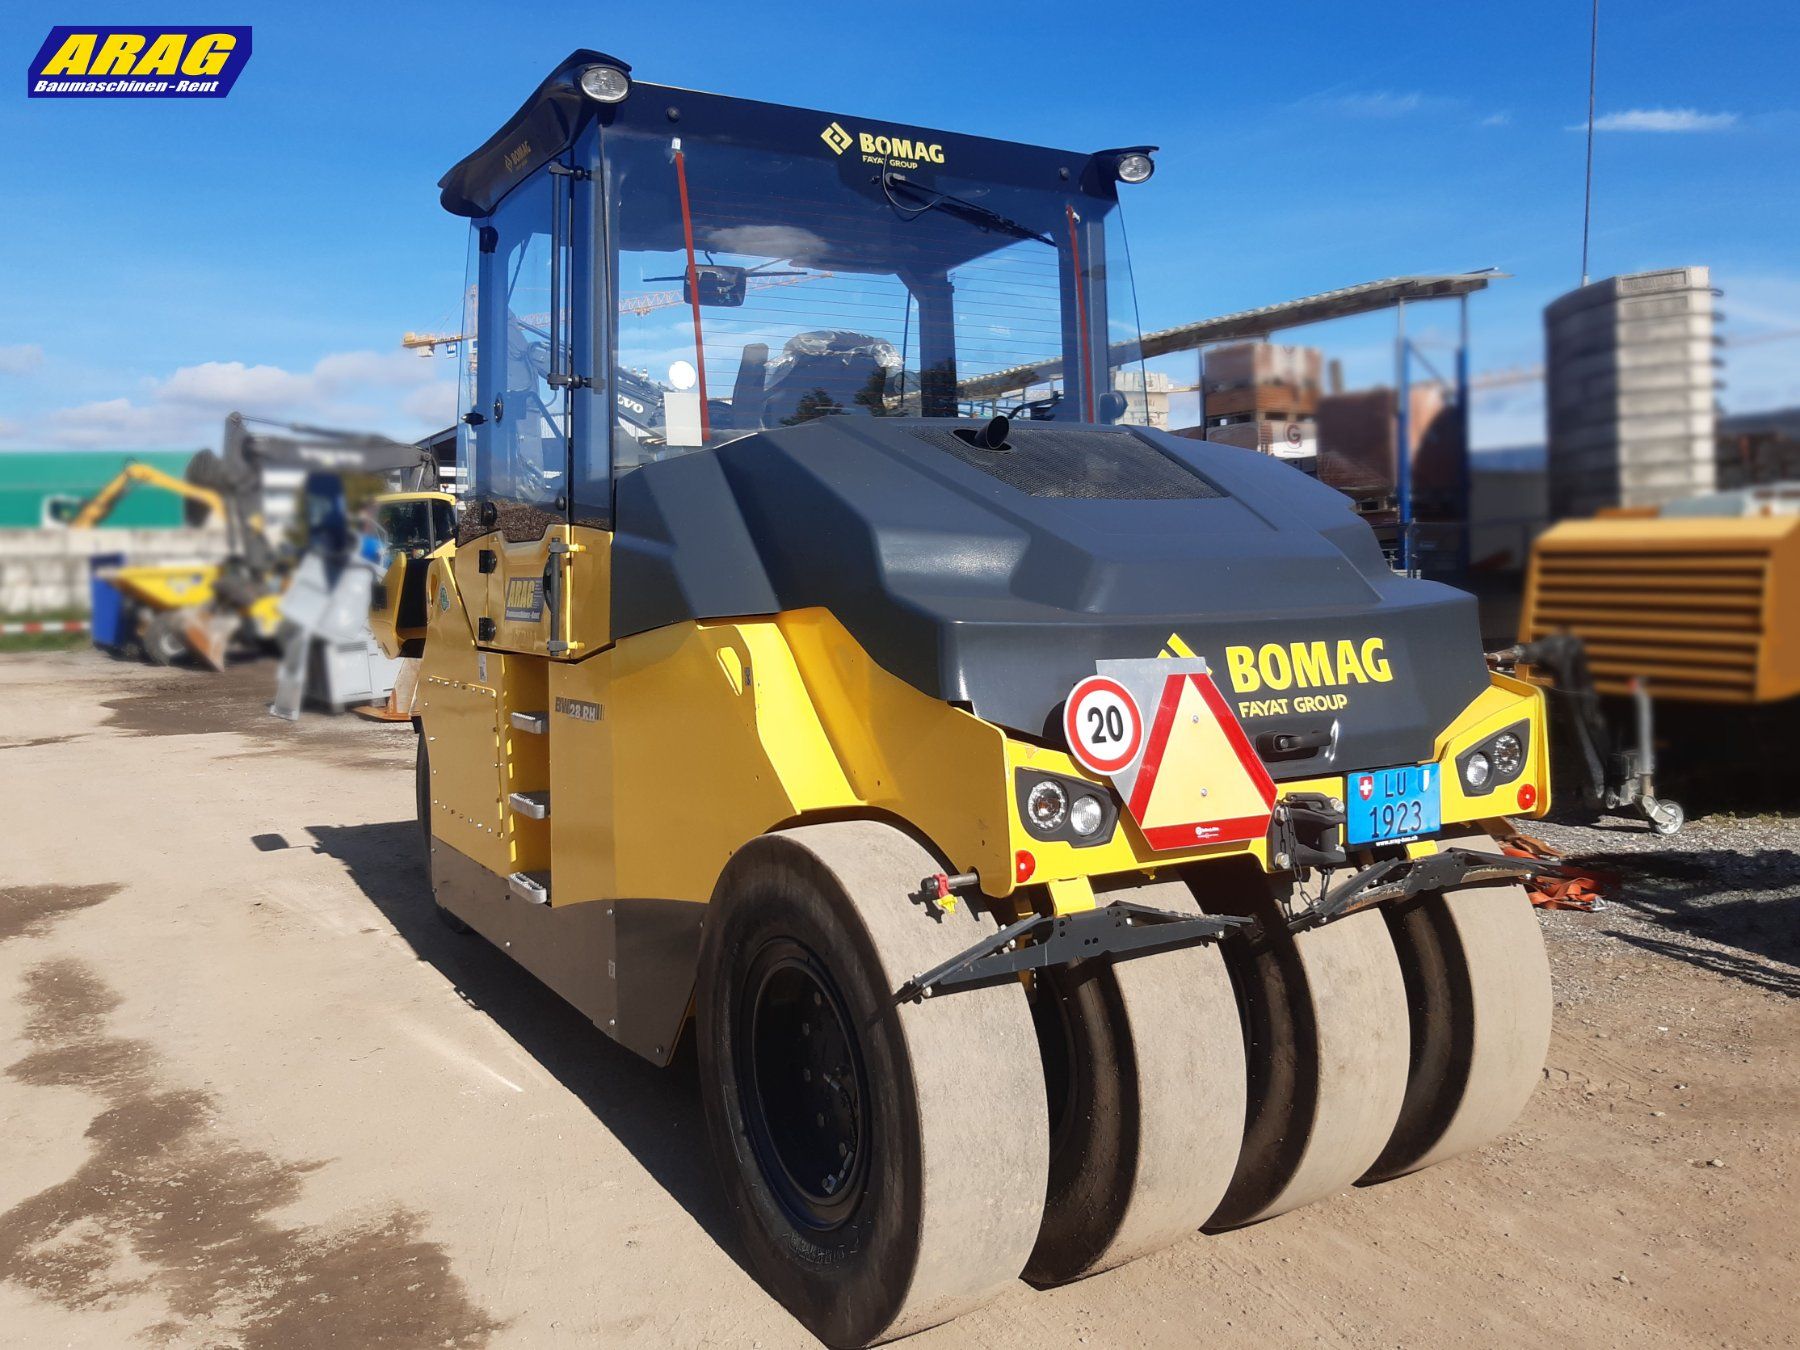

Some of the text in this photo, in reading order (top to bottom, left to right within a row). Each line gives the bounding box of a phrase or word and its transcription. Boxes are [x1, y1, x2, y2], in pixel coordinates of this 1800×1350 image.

[859, 132, 945, 163] BOMAG
[889, 159, 918, 169] GROUP
[506, 580, 535, 609] ARAG
[1225, 637, 1394, 693] BOMAG
[1238, 694, 1348, 718] FAYAT GROUP
[1087, 704, 1124, 744] 20
[1385, 771, 1407, 798] LU
[1369, 800, 1422, 839] 1923
